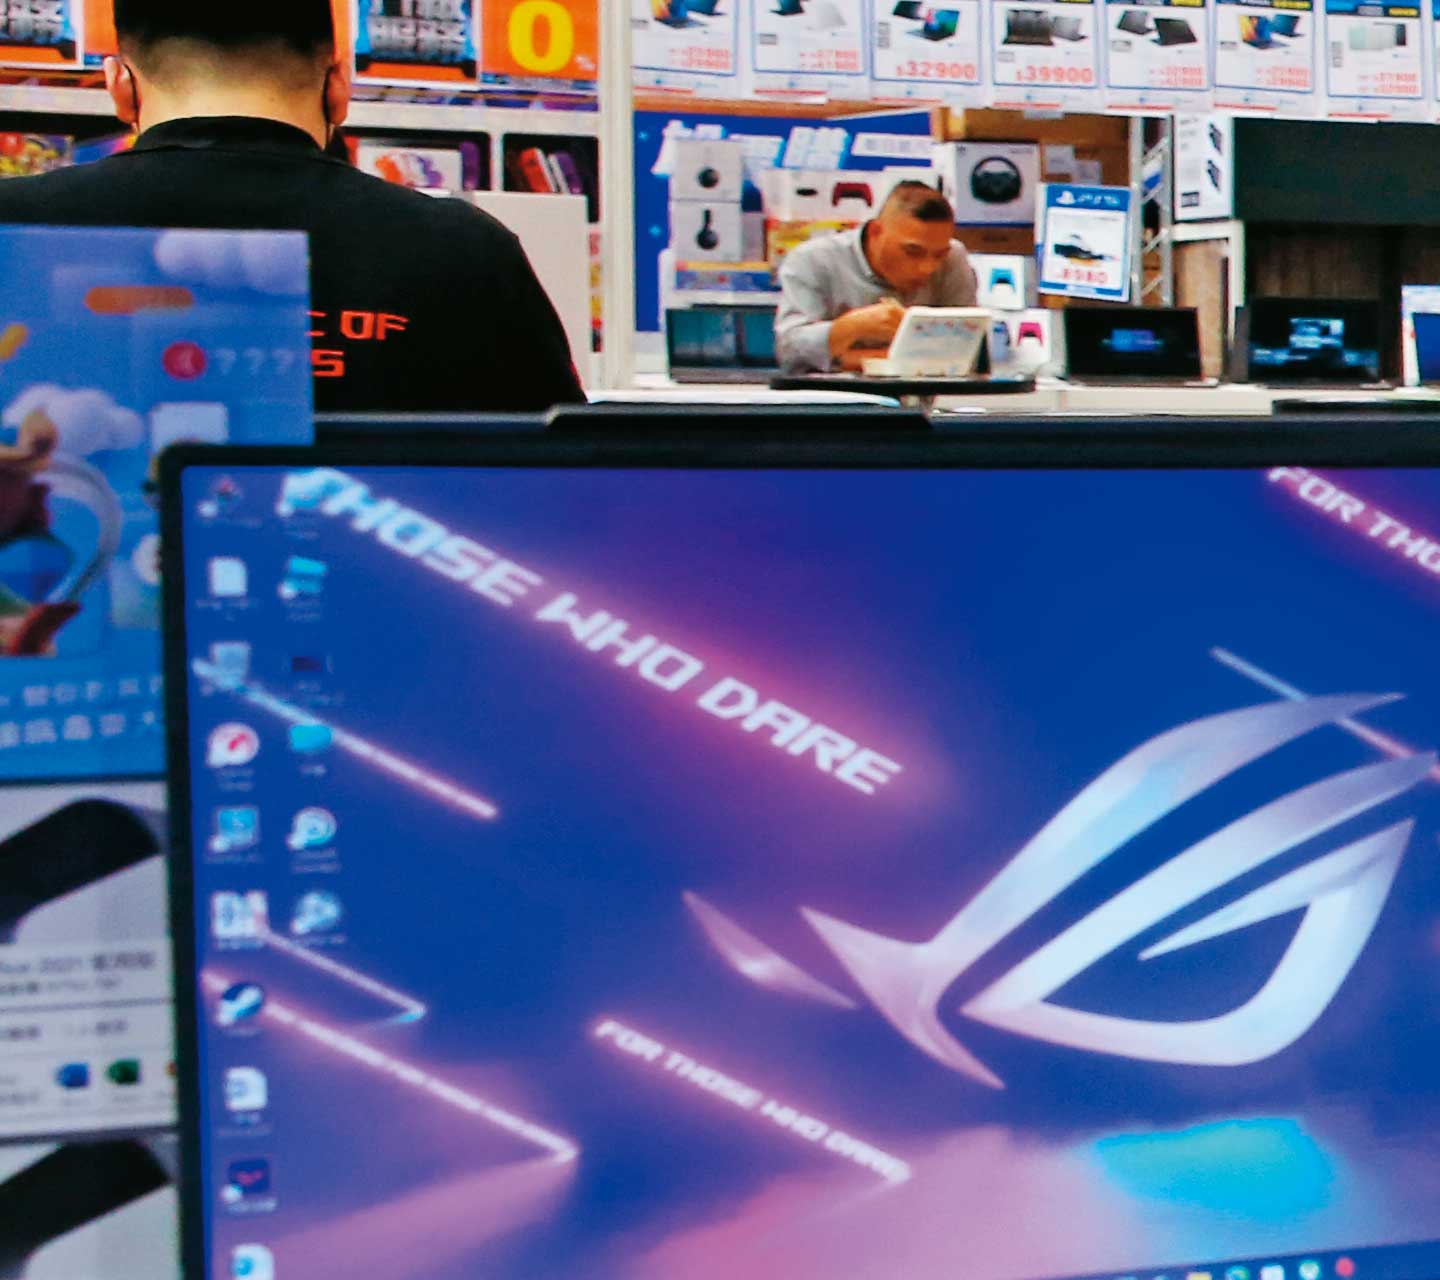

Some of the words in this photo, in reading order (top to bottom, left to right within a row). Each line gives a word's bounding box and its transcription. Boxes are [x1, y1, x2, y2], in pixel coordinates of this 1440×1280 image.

[340, 310, 410, 340] OF
[537, 593, 702, 692] WHO
[700, 677, 903, 795] DARE
